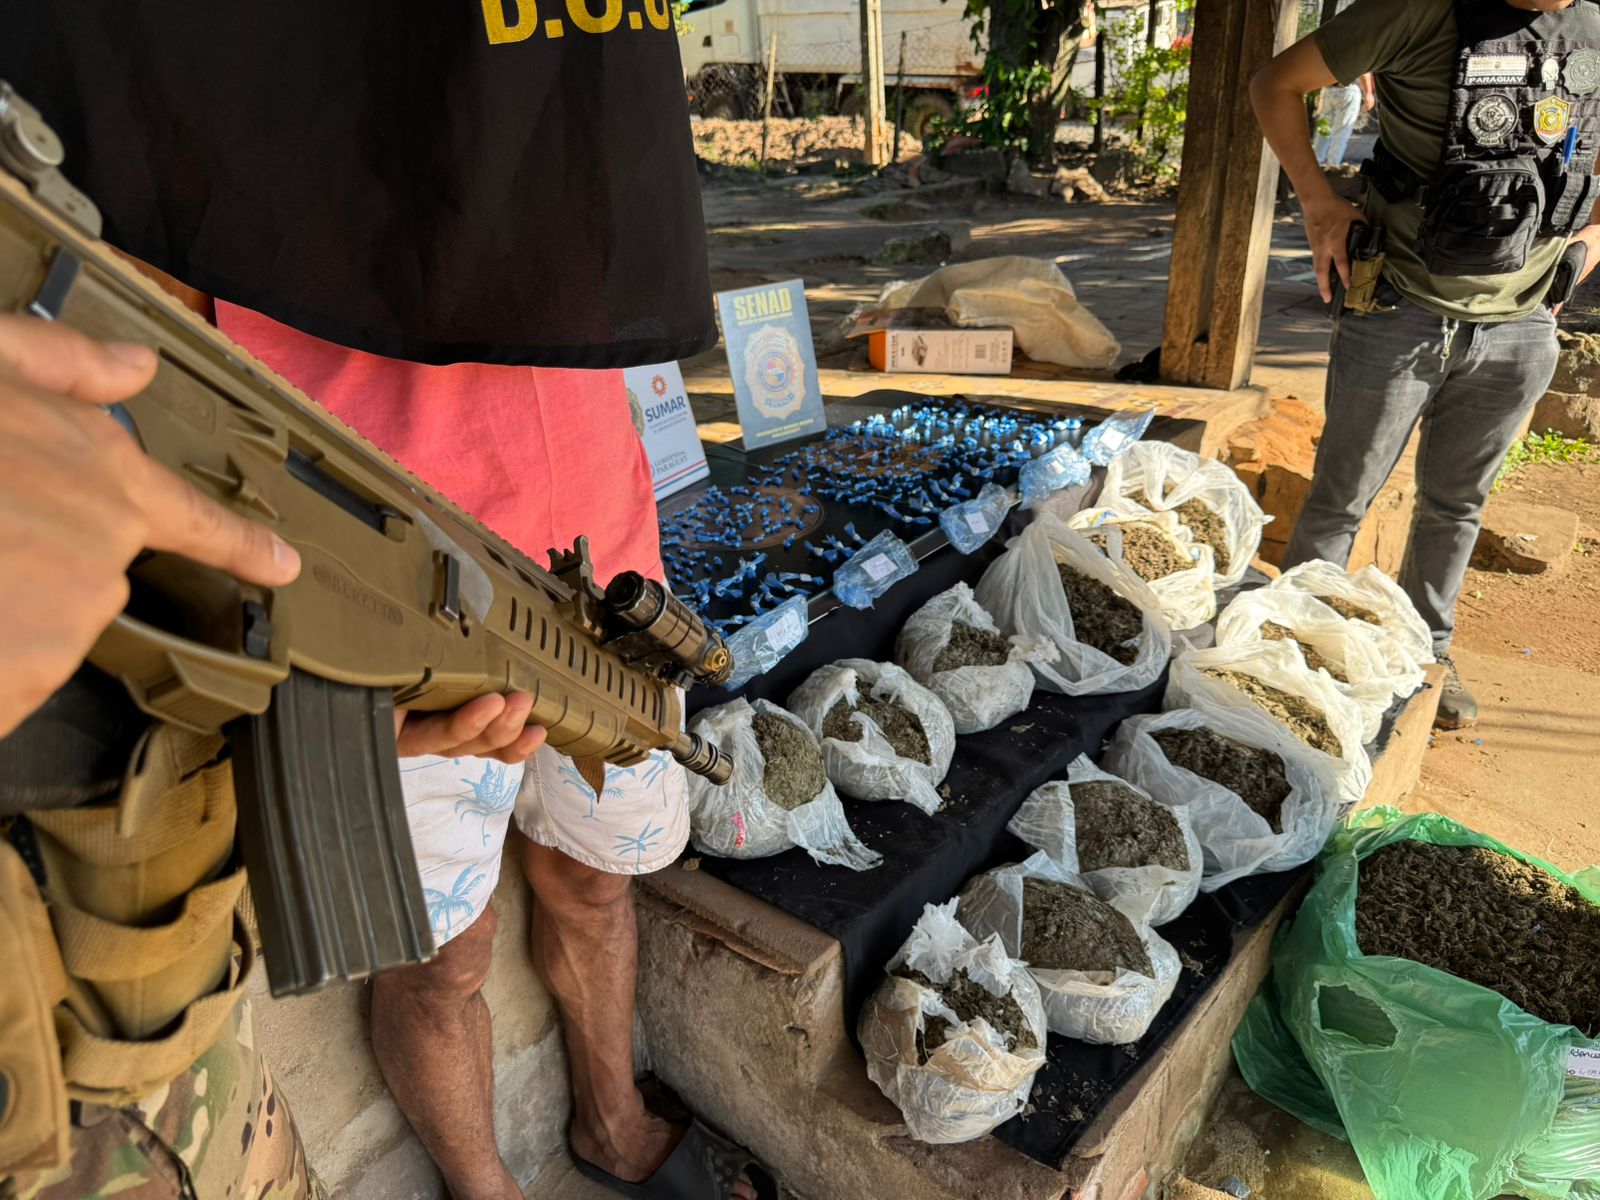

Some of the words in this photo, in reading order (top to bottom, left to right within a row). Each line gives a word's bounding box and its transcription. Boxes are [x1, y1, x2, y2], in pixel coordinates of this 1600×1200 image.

[1468, 76, 1524, 84] PARAGUAY
[734, 287, 793, 321] SENAD
[644, 395, 687, 423] SUMAR
